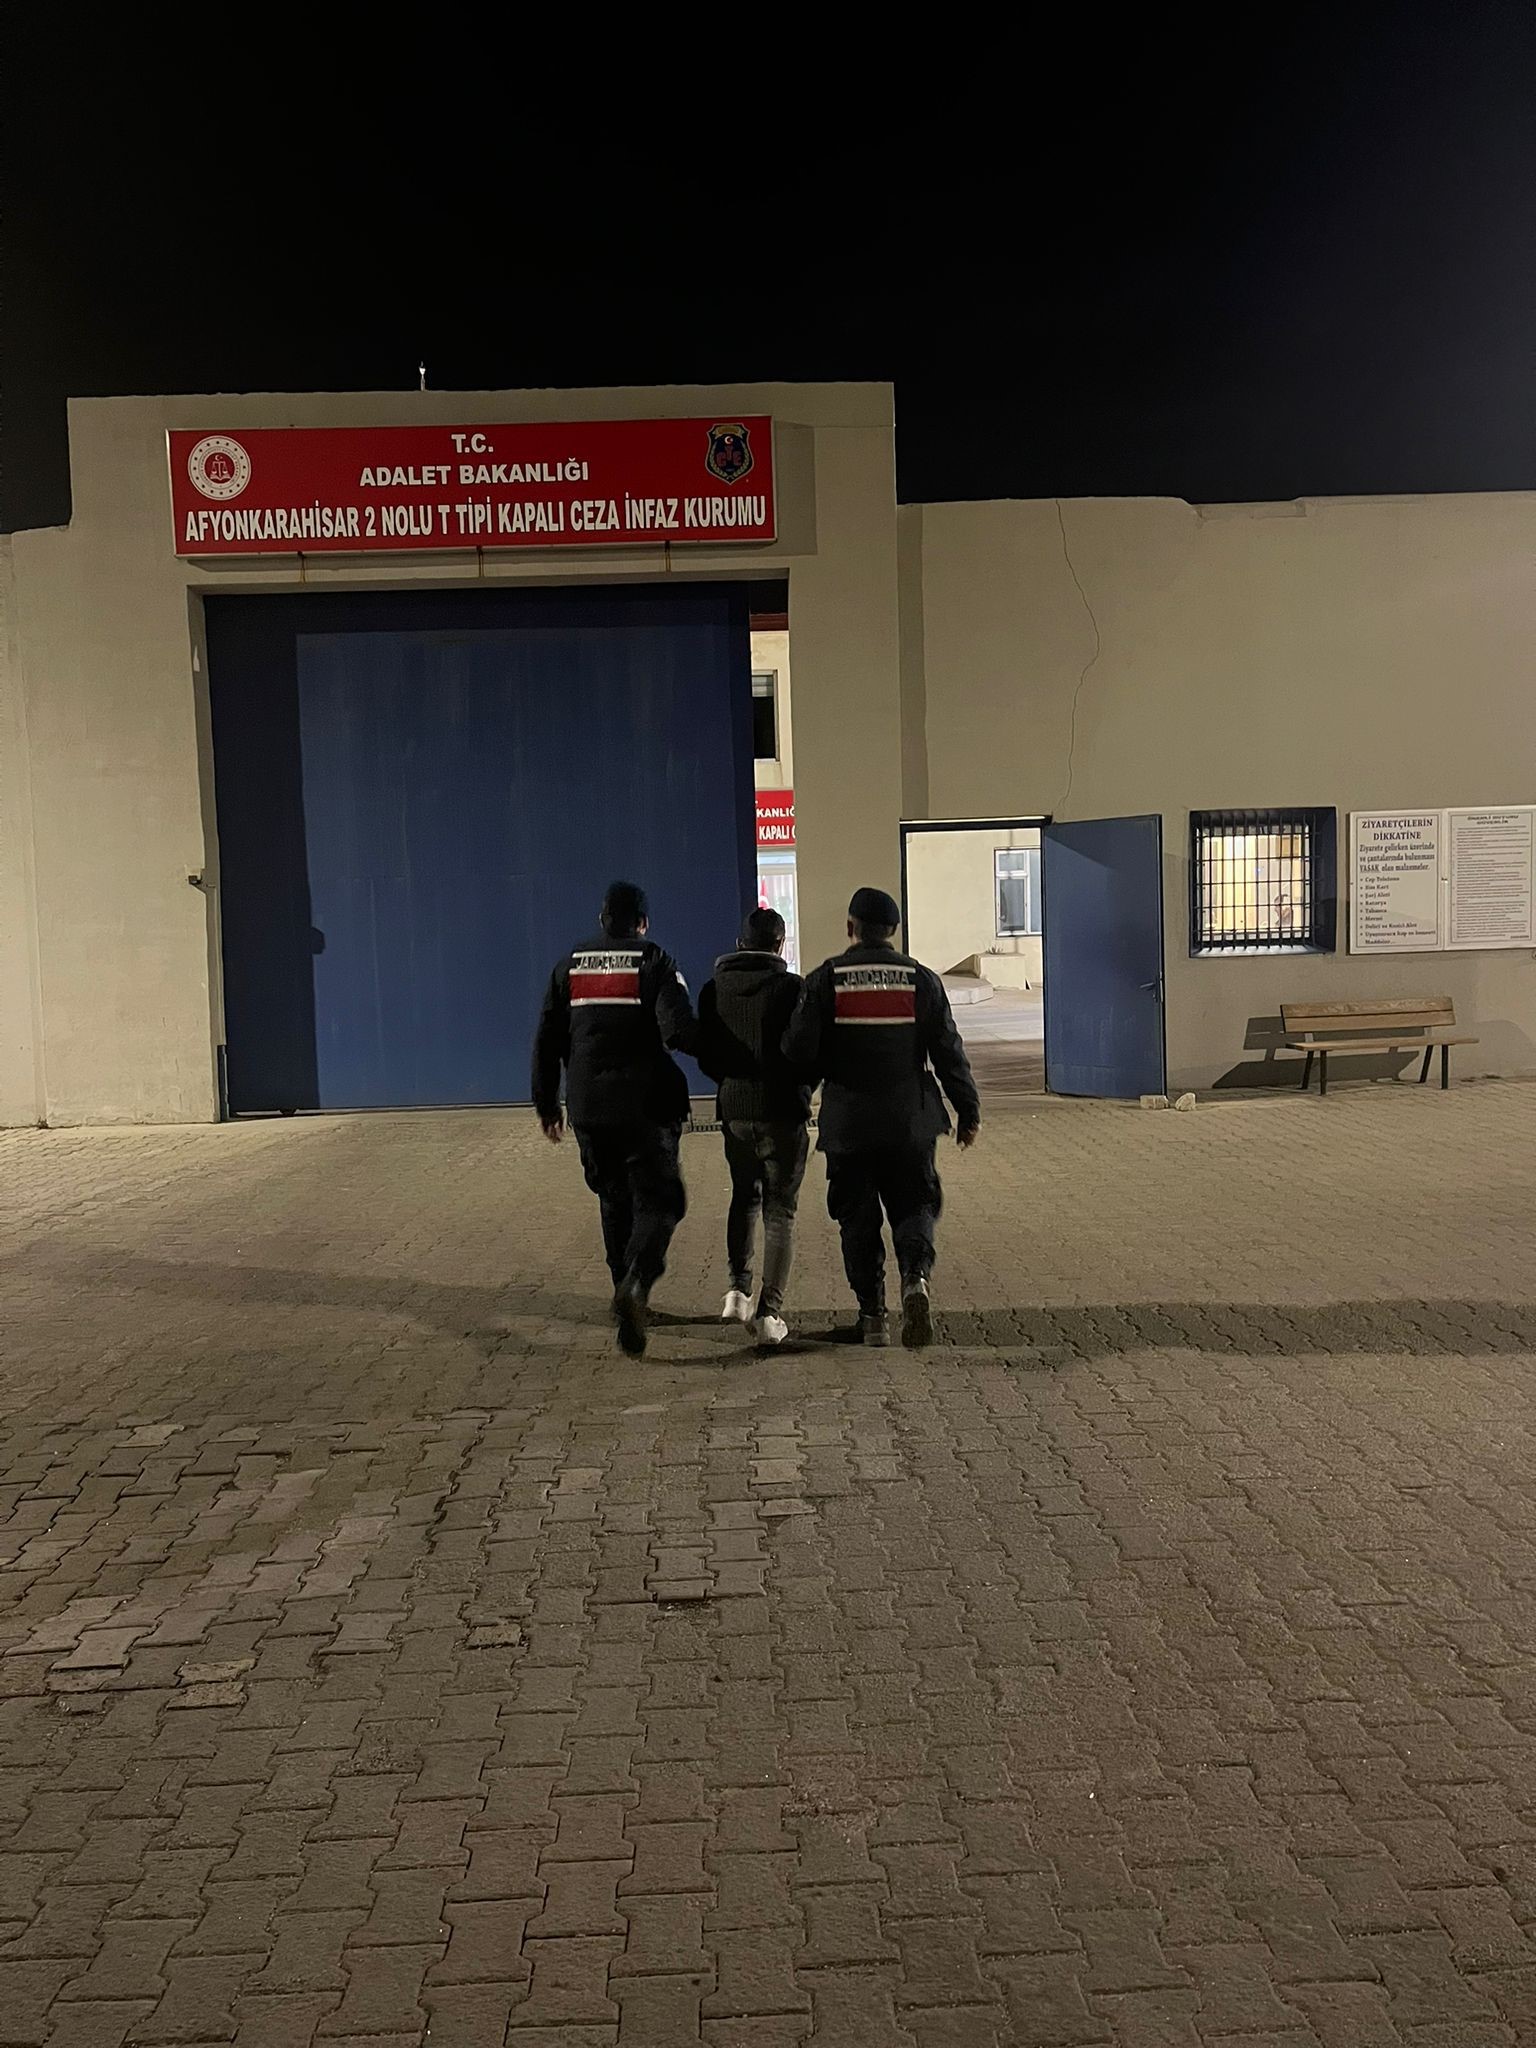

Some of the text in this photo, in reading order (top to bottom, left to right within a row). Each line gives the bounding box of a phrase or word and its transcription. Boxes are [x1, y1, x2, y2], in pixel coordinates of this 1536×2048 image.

[451, 433, 494, 454] T.C.
[360, 457, 589, 487] ADALET BAKANLIĞI
[185, 491, 767, 542] AFYONKARAHİSAR 2 NOLU T TİPİ KAPALI CEZA İNFAZ KURUMU
[1361, 819, 1433, 829] ZİYARETÇİLERİN
[759, 825, 790, 840] KAPALI
[1373, 830, 1422, 841] DİKKATİNE
[843, 970, 910, 986] JANDARMA
